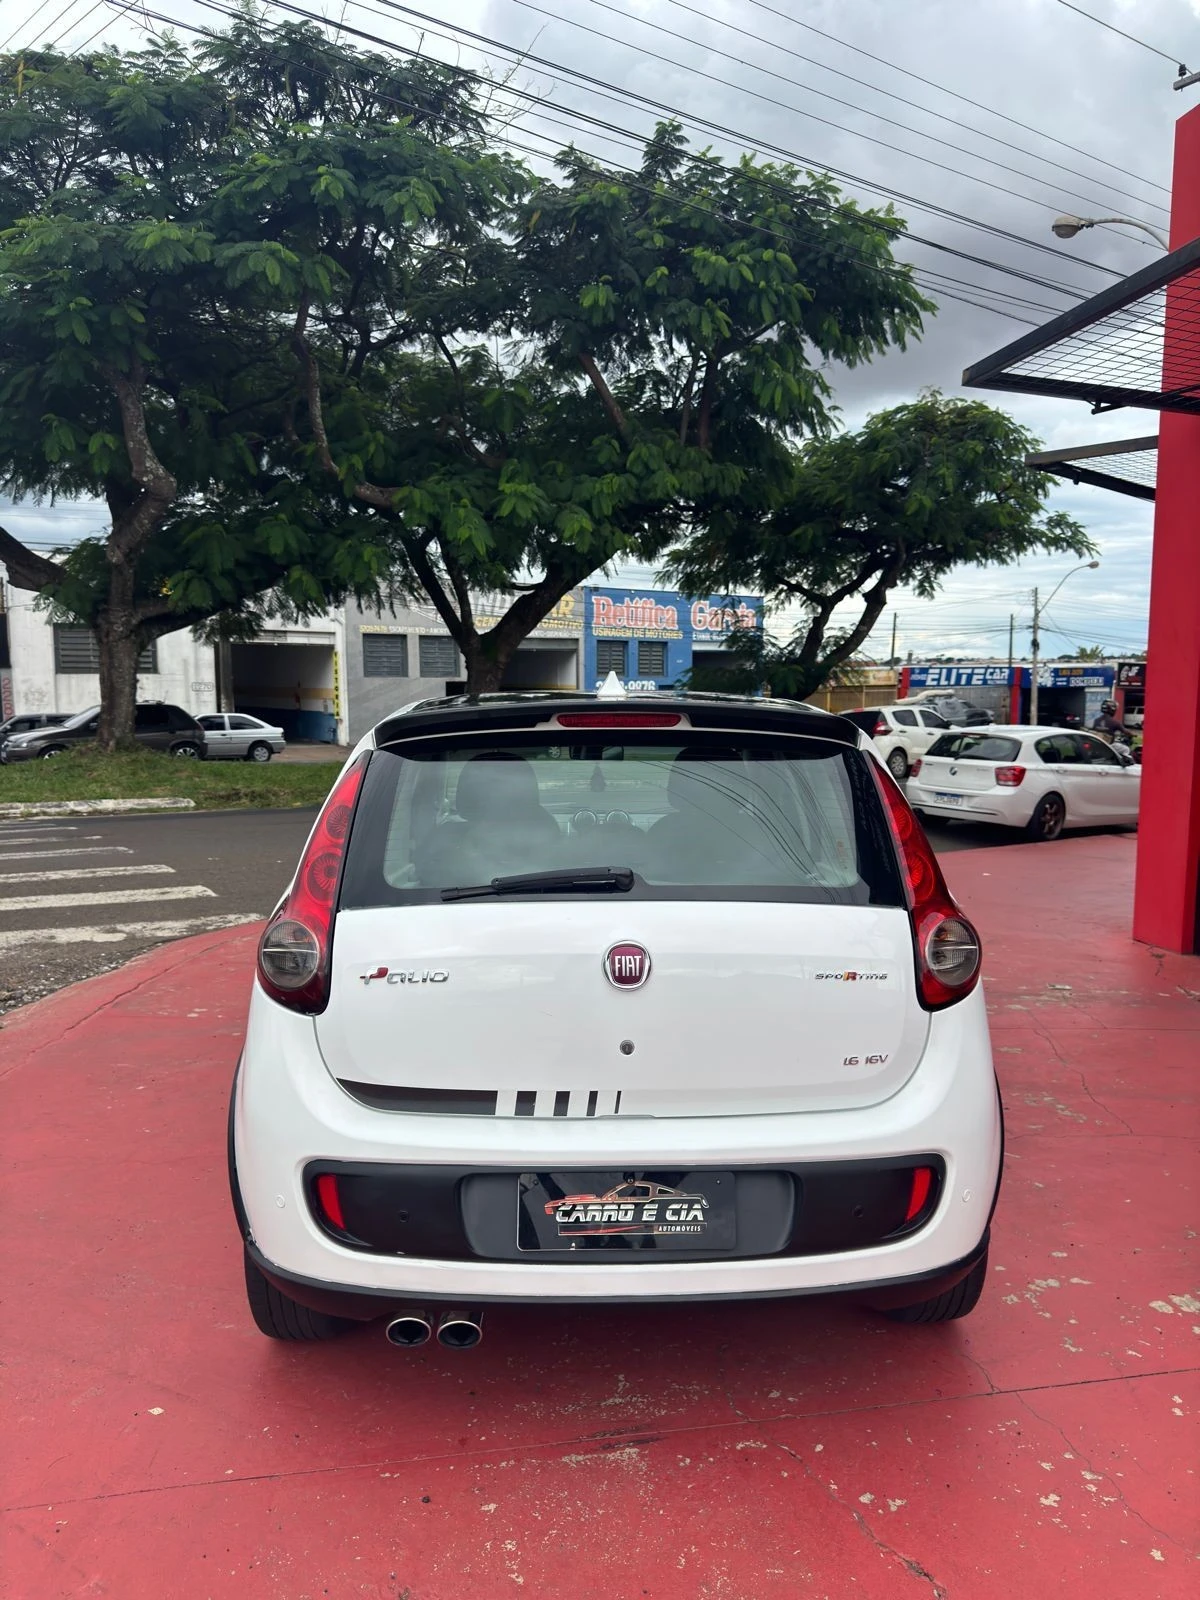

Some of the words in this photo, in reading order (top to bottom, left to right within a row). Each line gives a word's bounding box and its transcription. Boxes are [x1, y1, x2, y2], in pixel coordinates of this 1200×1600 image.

[634, 629, 645, 638] DE
[645, 629, 684, 639] MOTORES
[925, 668, 986, 686] ELITE
[614, 955, 642, 977] FIAT
[864, 1053, 889, 1065] 16V
[556, 1203, 634, 1222] CARRO
[642, 1203, 658, 1221] E
[666, 1203, 704, 1221] CIA
